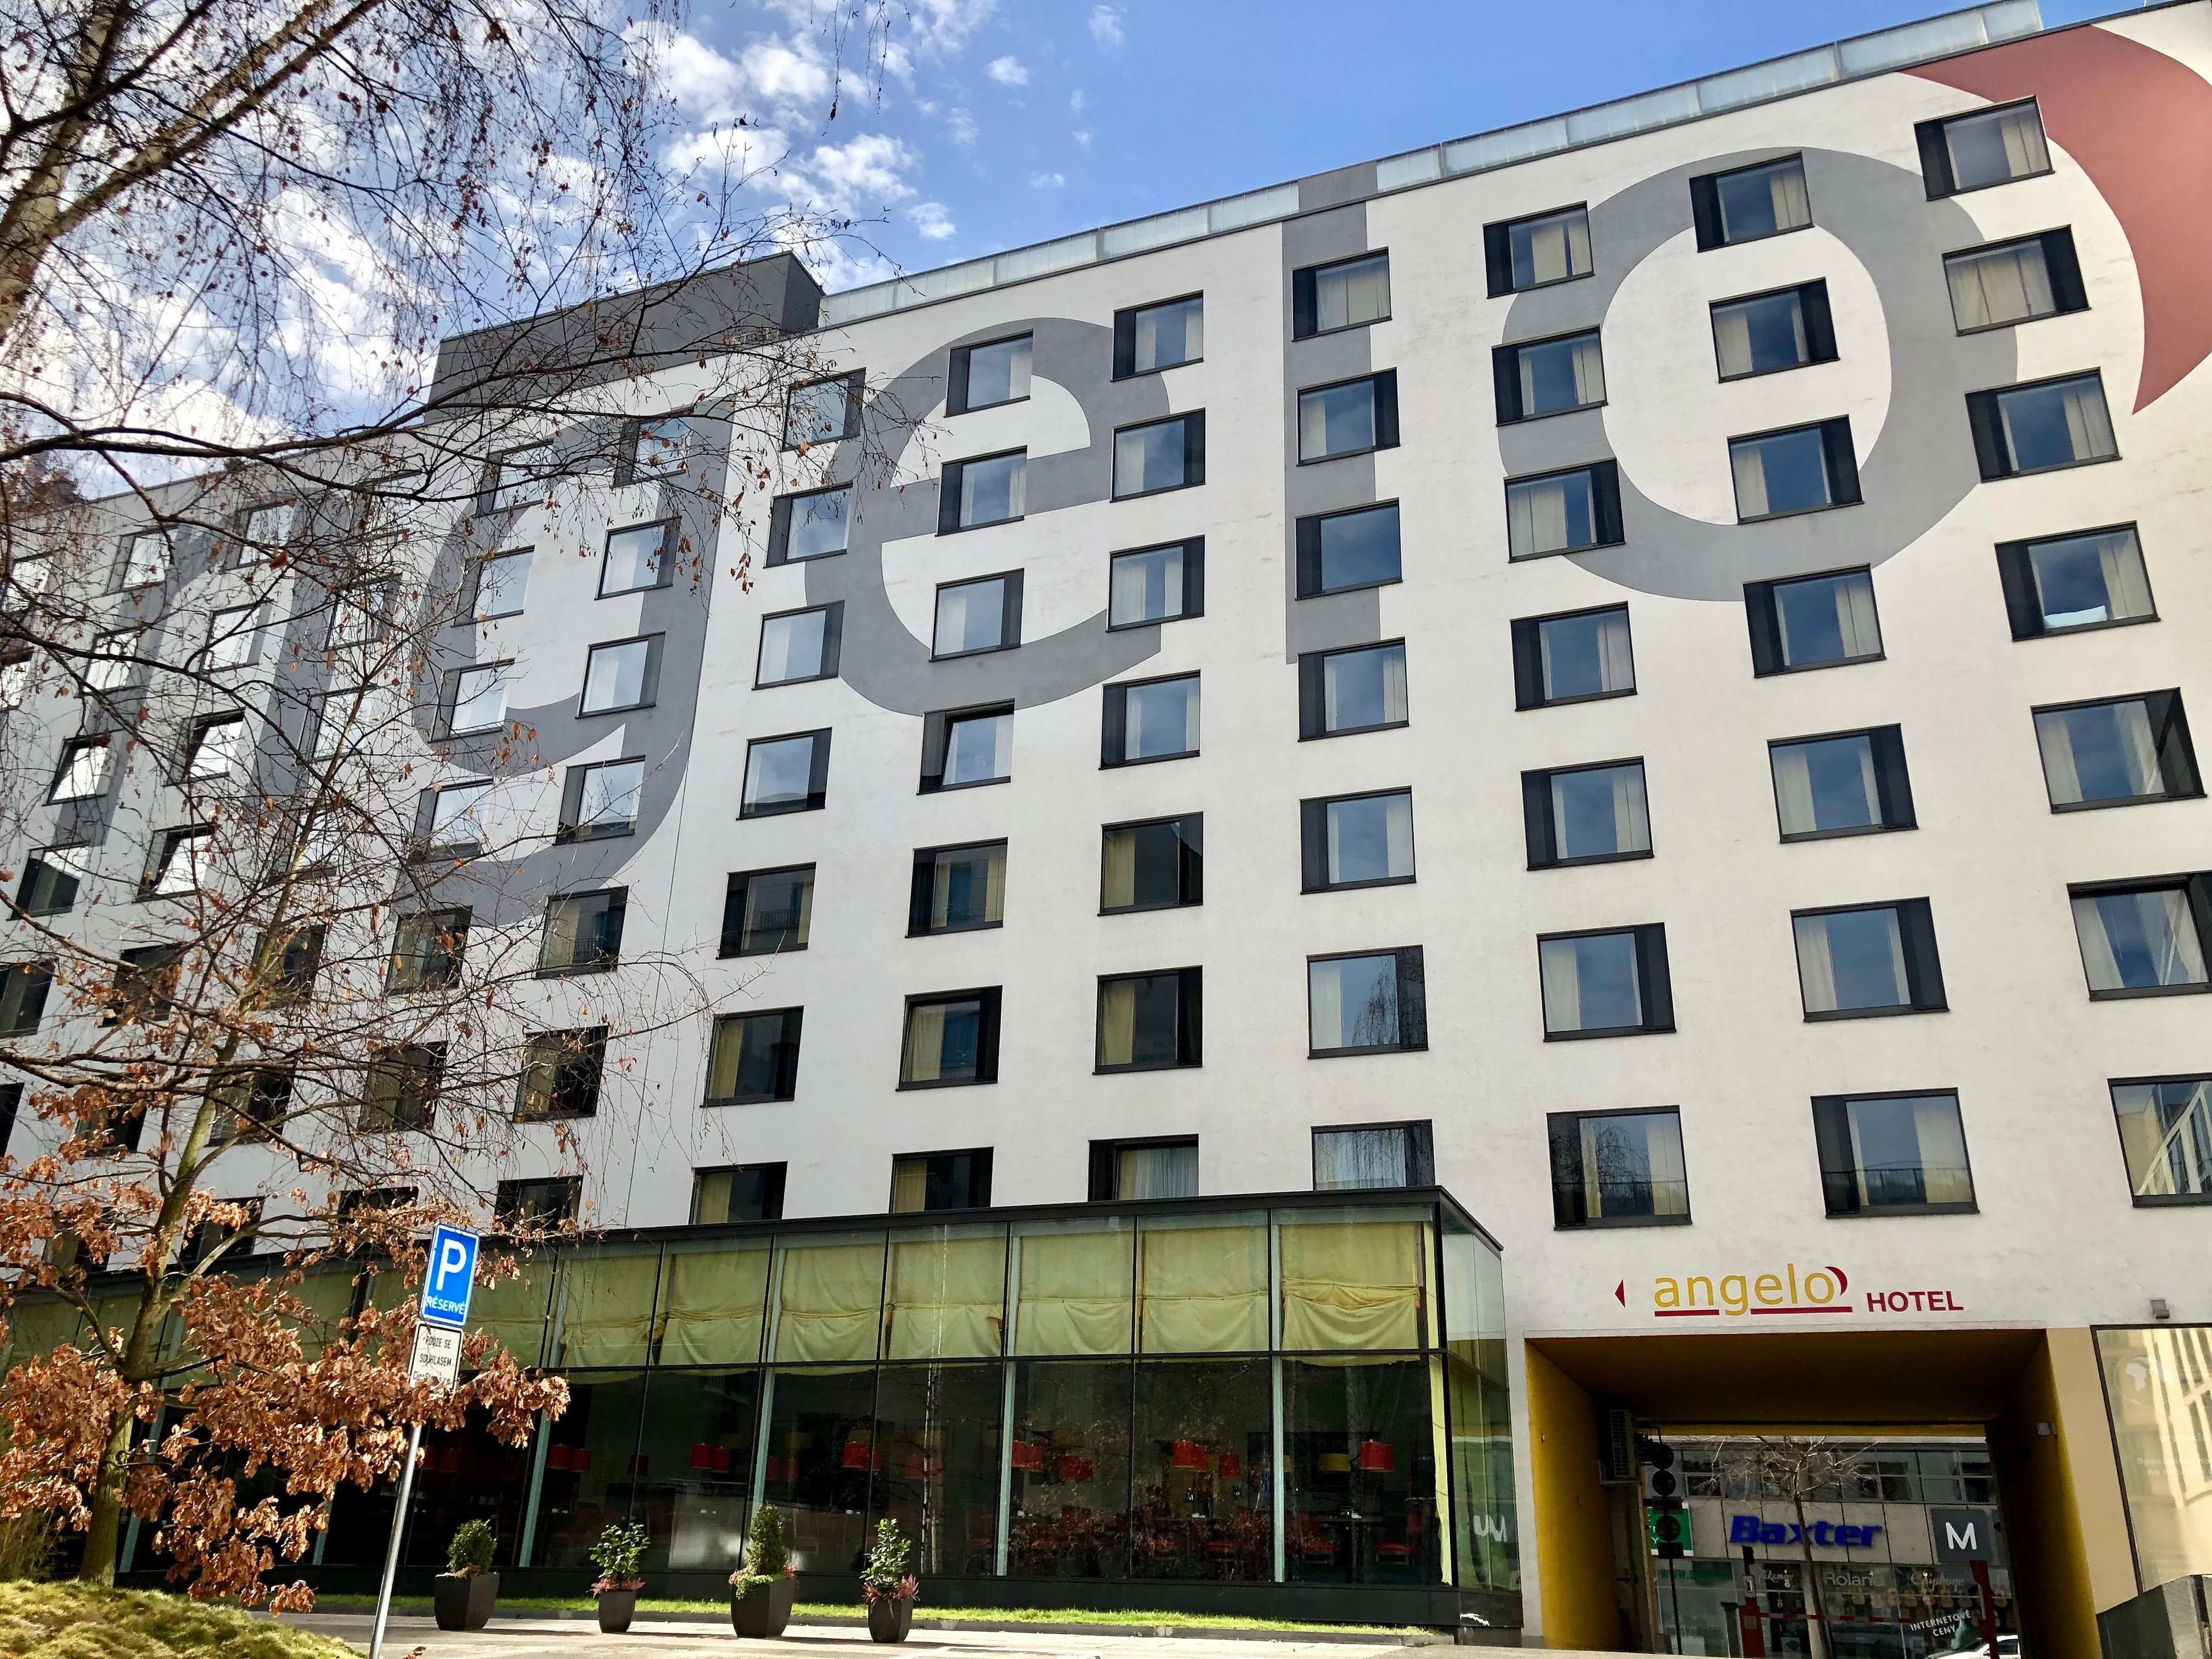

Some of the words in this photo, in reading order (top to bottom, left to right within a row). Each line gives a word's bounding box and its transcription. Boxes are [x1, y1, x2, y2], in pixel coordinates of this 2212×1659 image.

[435, 1238, 467, 1291] P
[1654, 1263, 1835, 1316] angelo
[1866, 1290, 1964, 1312] HOTEL
[425, 1294, 465, 1315] RÉSERVÉ
[444, 1339, 452, 1349] SE
[1729, 1515, 1883, 1547] Baxter
[1945, 1521, 1978, 1551] M
[1910, 1609, 1972, 1631] INTERNETOVÉ
[1932, 1624, 1956, 1637] CENY
